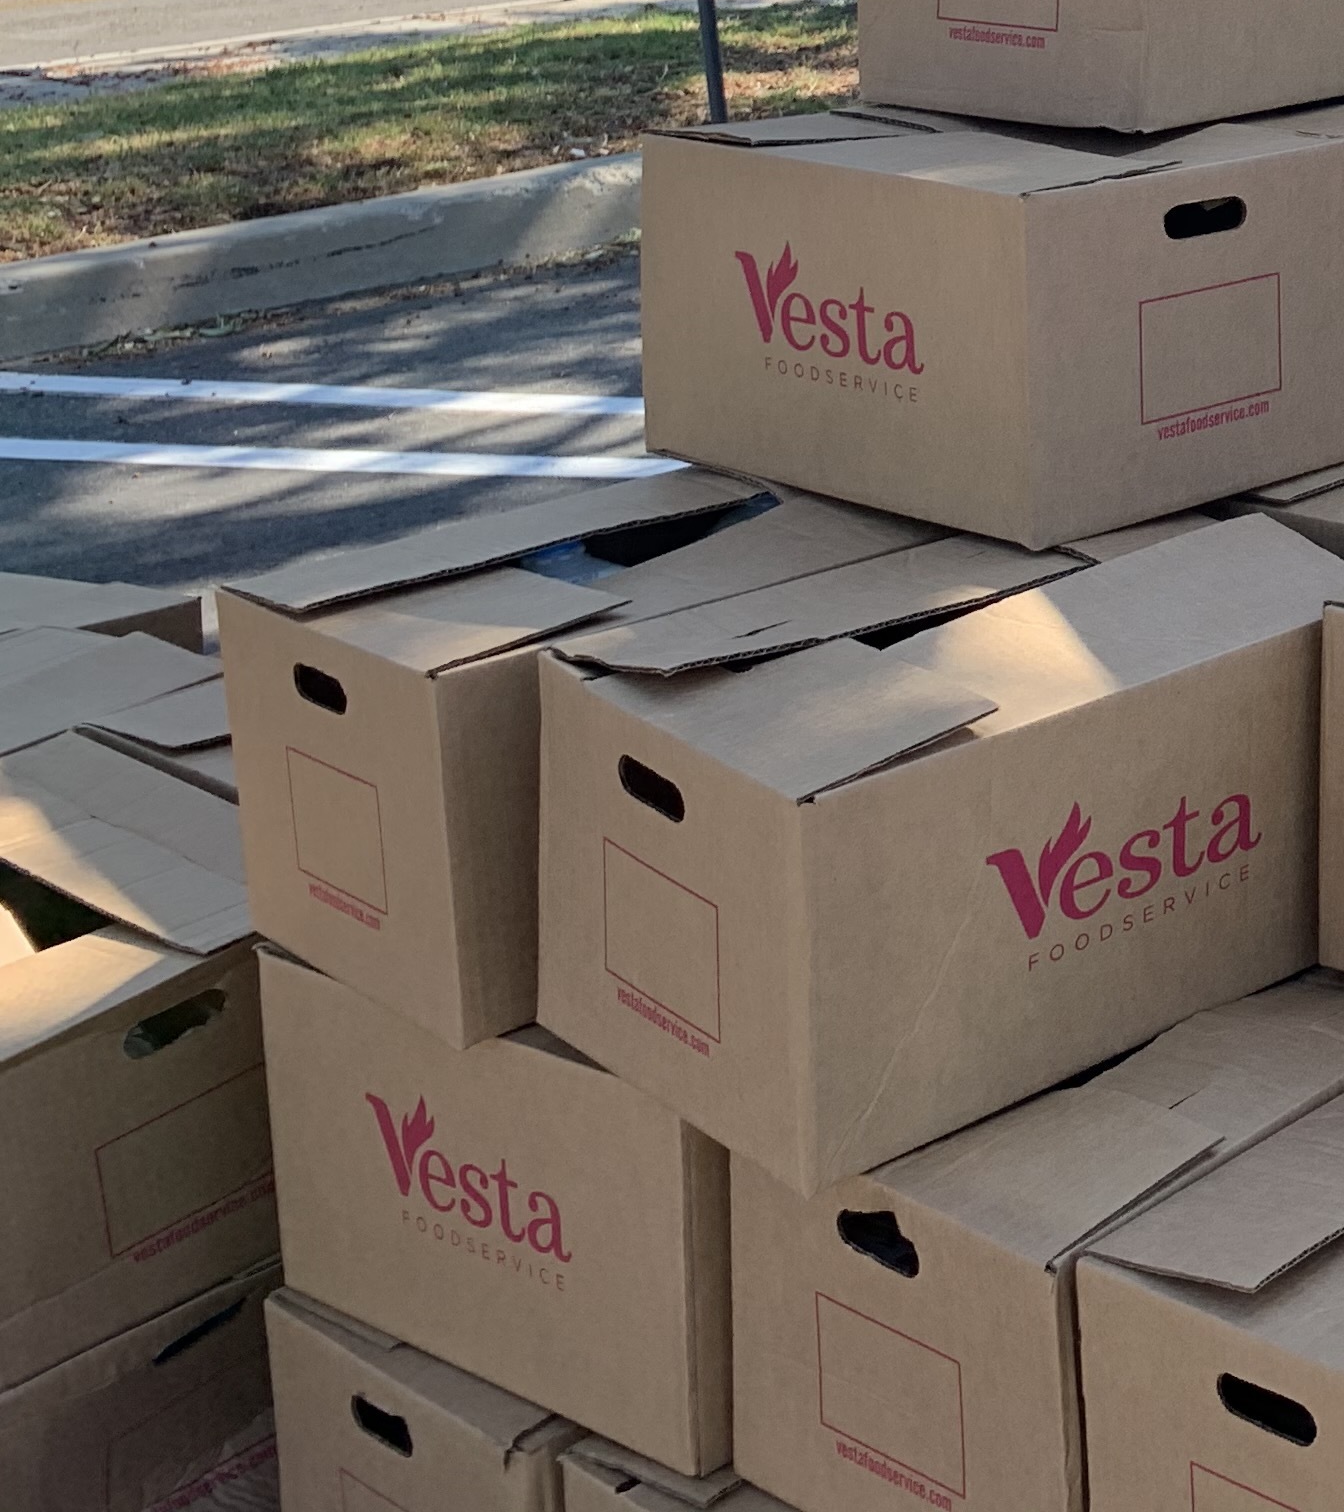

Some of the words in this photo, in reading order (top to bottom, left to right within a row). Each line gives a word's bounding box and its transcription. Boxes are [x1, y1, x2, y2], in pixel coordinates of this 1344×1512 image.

[949, 26, 1046, 49] vestafoodservice.com
[734, 240, 925, 376] Vesta
[764, 356, 919, 403] FOODSERVICE
[1156, 400, 1270, 442] vestafoodservice.com
[985, 793, 1263, 940] Vesta
[1028, 864, 1251, 972] FOODSERVICE
[617, 986, 710, 1059] vestafoodservice.com
[365, 1091, 573, 1264] Vesta
[401, 1209, 565, 1292] FOODSERVICE
[836, 1439, 952, 1512] vestafoodservice.com
